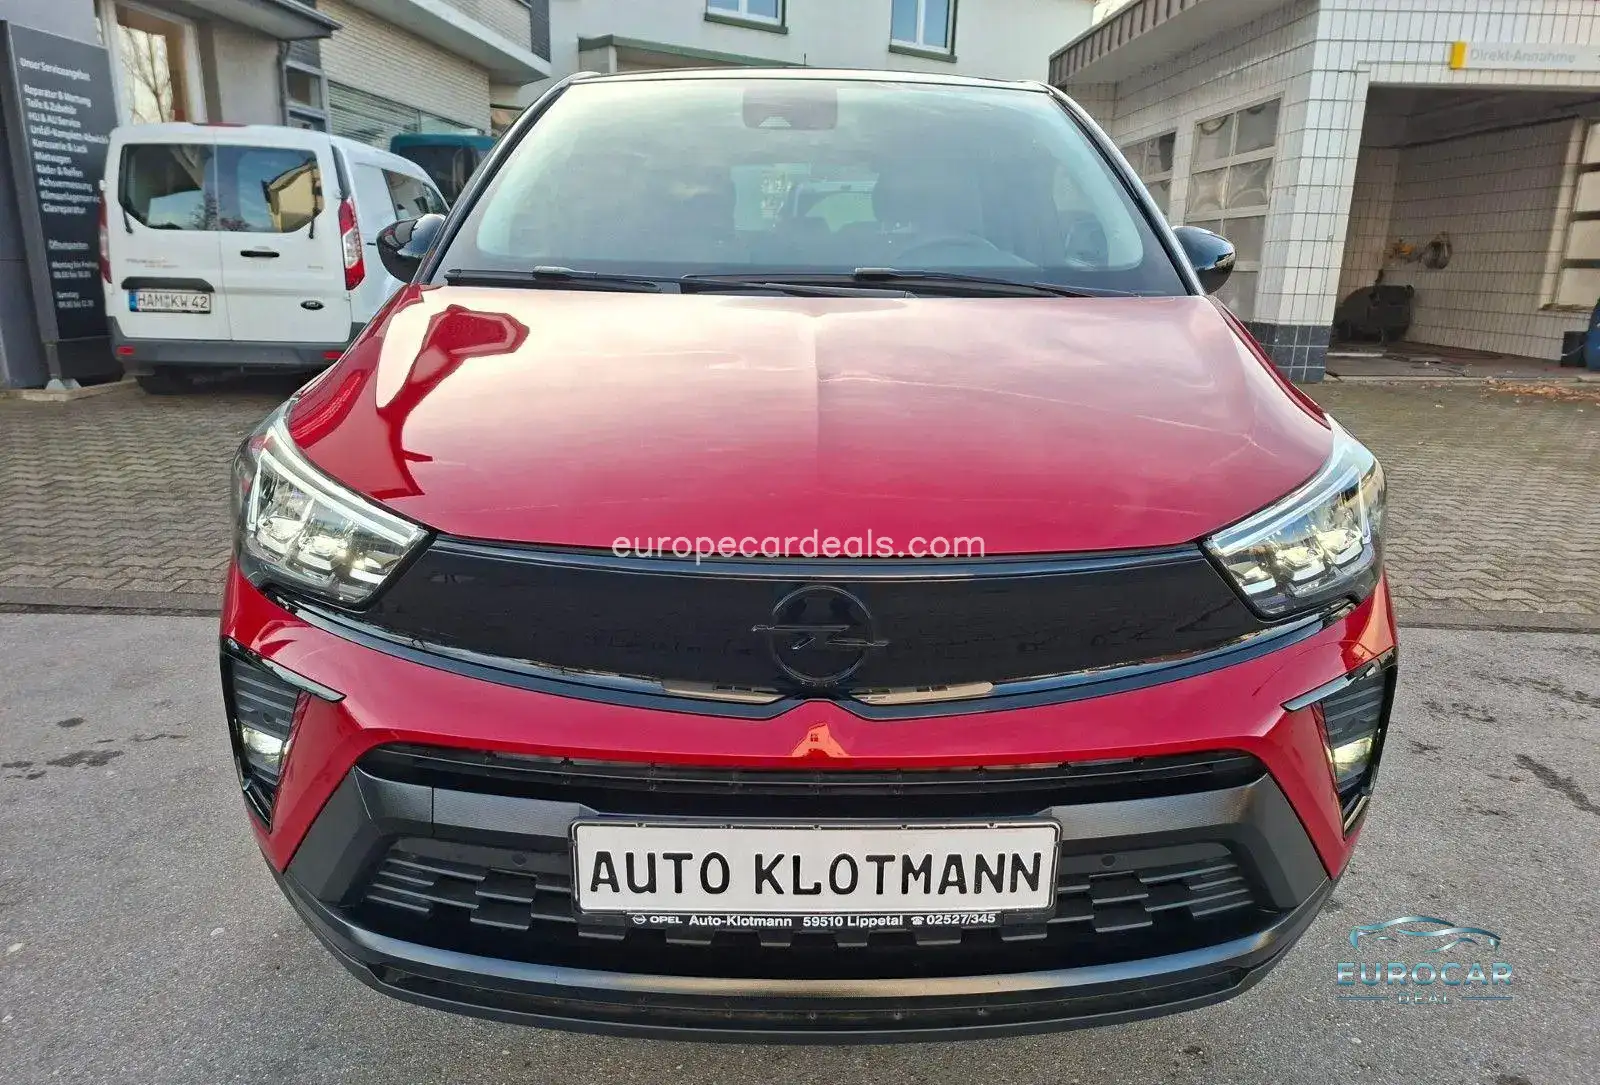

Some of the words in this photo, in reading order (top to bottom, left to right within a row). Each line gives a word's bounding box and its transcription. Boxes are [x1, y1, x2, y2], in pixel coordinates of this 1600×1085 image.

[1470, 48, 1576, 63] Direkt-Annahme
[20, 57, 40, 69] Unser
[24, 84, 57, 98] Reparatur
[57, 115, 81, 128] Service
[138, 294, 163, 306] HAM
[171, 295, 187, 307] KW
[192, 296, 208, 308] 42
[590, 851, 730, 895] AUTO
[754, 852, 1042, 895] KLOTMANN
[650, 916, 683, 924] OPEL
[689, 914, 792, 927] Auto-Klotmann
[803, 915, 843, 926] 59510
[847, 914, 903, 928] Lippetal
[926, 913, 996, 925] 02527/345
